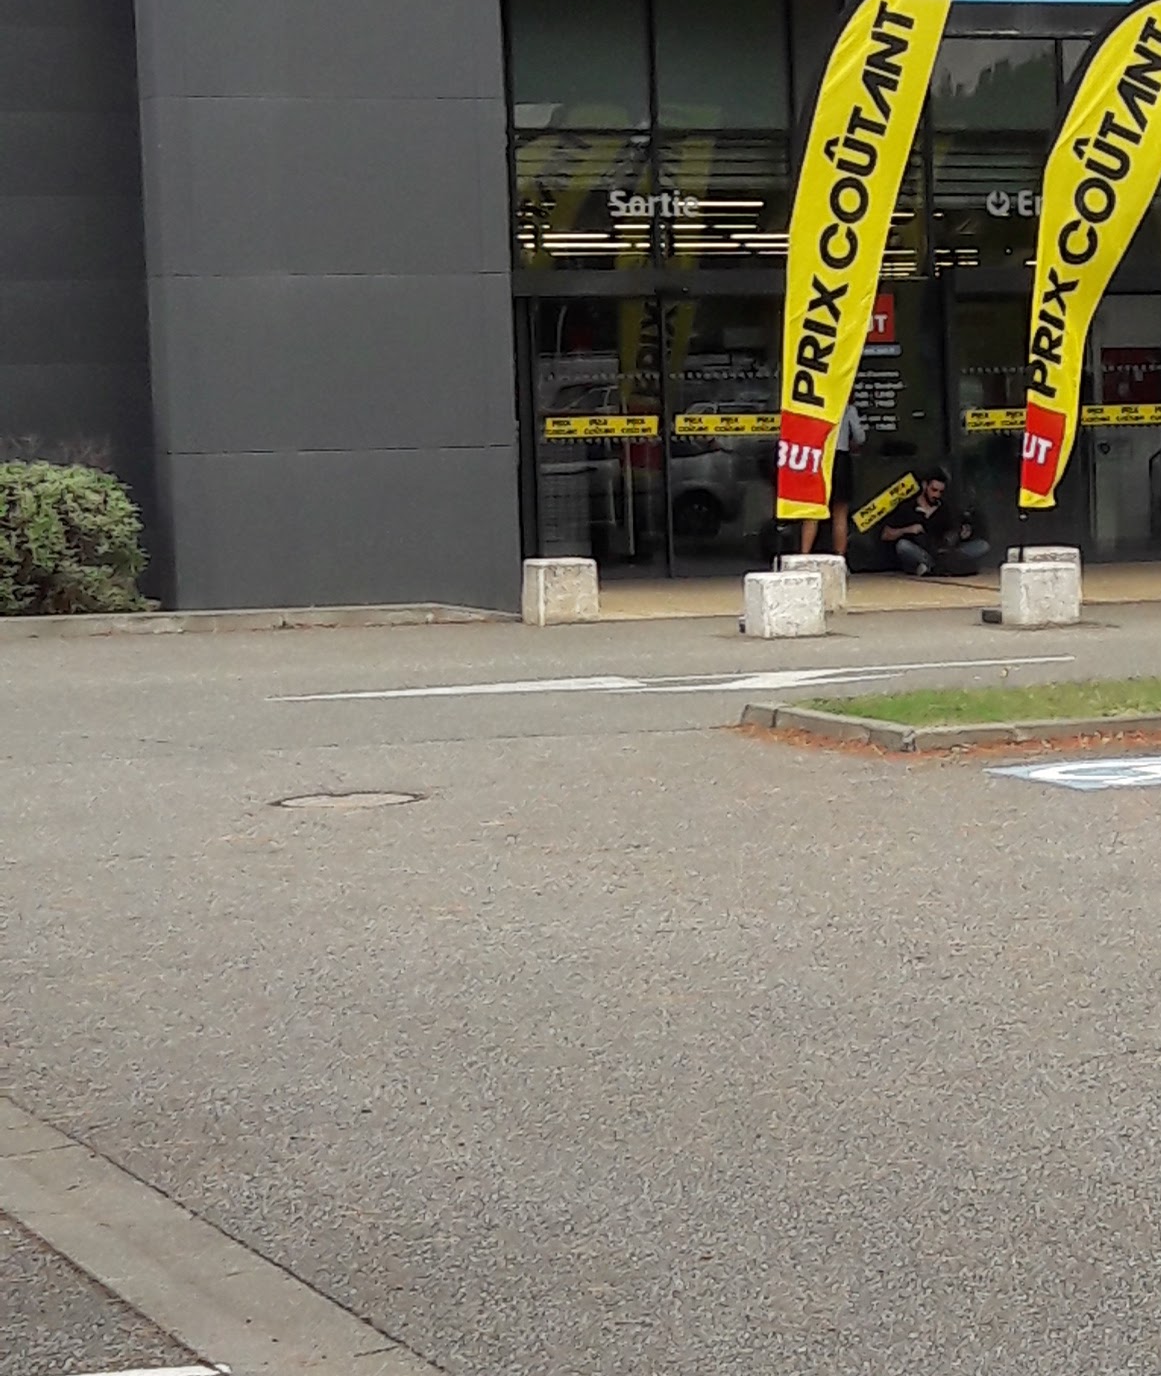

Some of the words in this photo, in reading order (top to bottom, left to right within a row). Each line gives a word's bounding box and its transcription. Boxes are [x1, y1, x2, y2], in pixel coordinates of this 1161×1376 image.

[819, 0, 915, 270] COÛTANT
[608, 190, 699, 217] Sortie
[792, 274, 849, 408] PRIX
[1028, 269, 1079, 398] PRIX
[1023, 432, 1053, 464] UT
